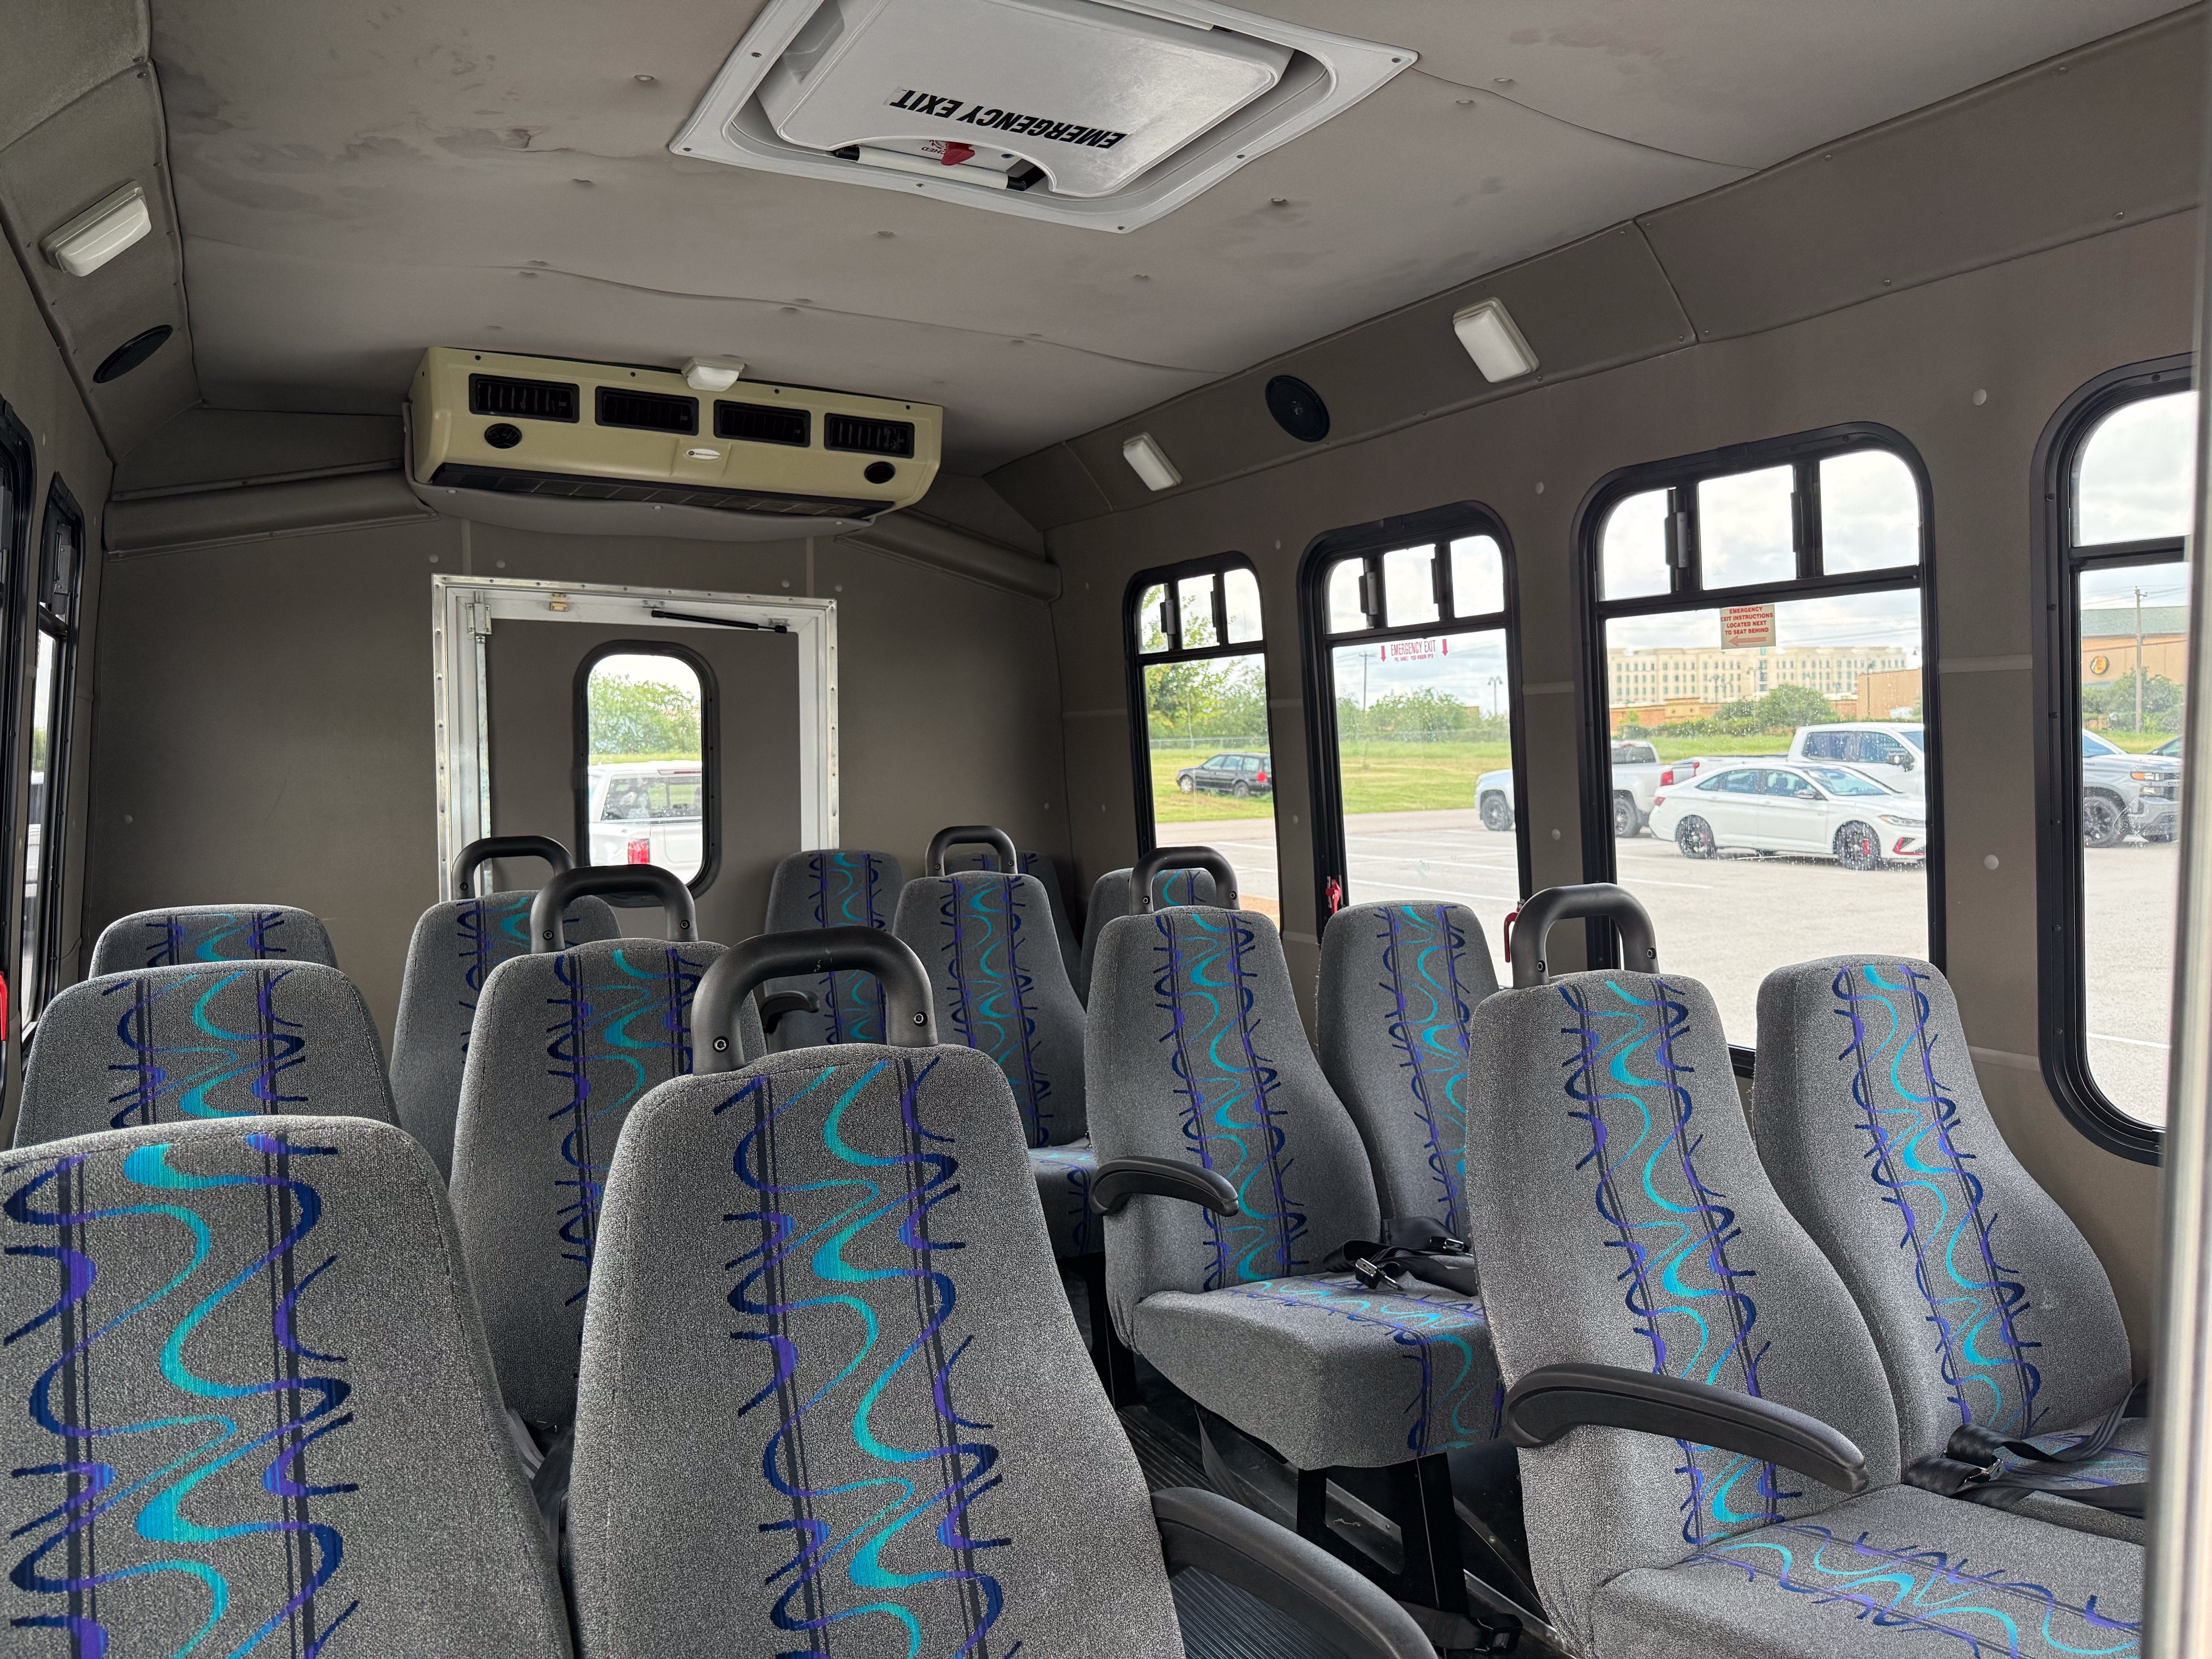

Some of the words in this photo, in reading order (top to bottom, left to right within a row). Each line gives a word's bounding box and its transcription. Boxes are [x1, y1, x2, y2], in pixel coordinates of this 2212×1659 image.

[889, 90, 964, 118] EXIT
[956, 105, 1128, 149] EMERGENCY
[1733, 613, 1773, 621] INSTRUCTIONS
[1391, 641, 1422, 656] EMERGENCY
[1424, 640, 1436, 653] EXIT
